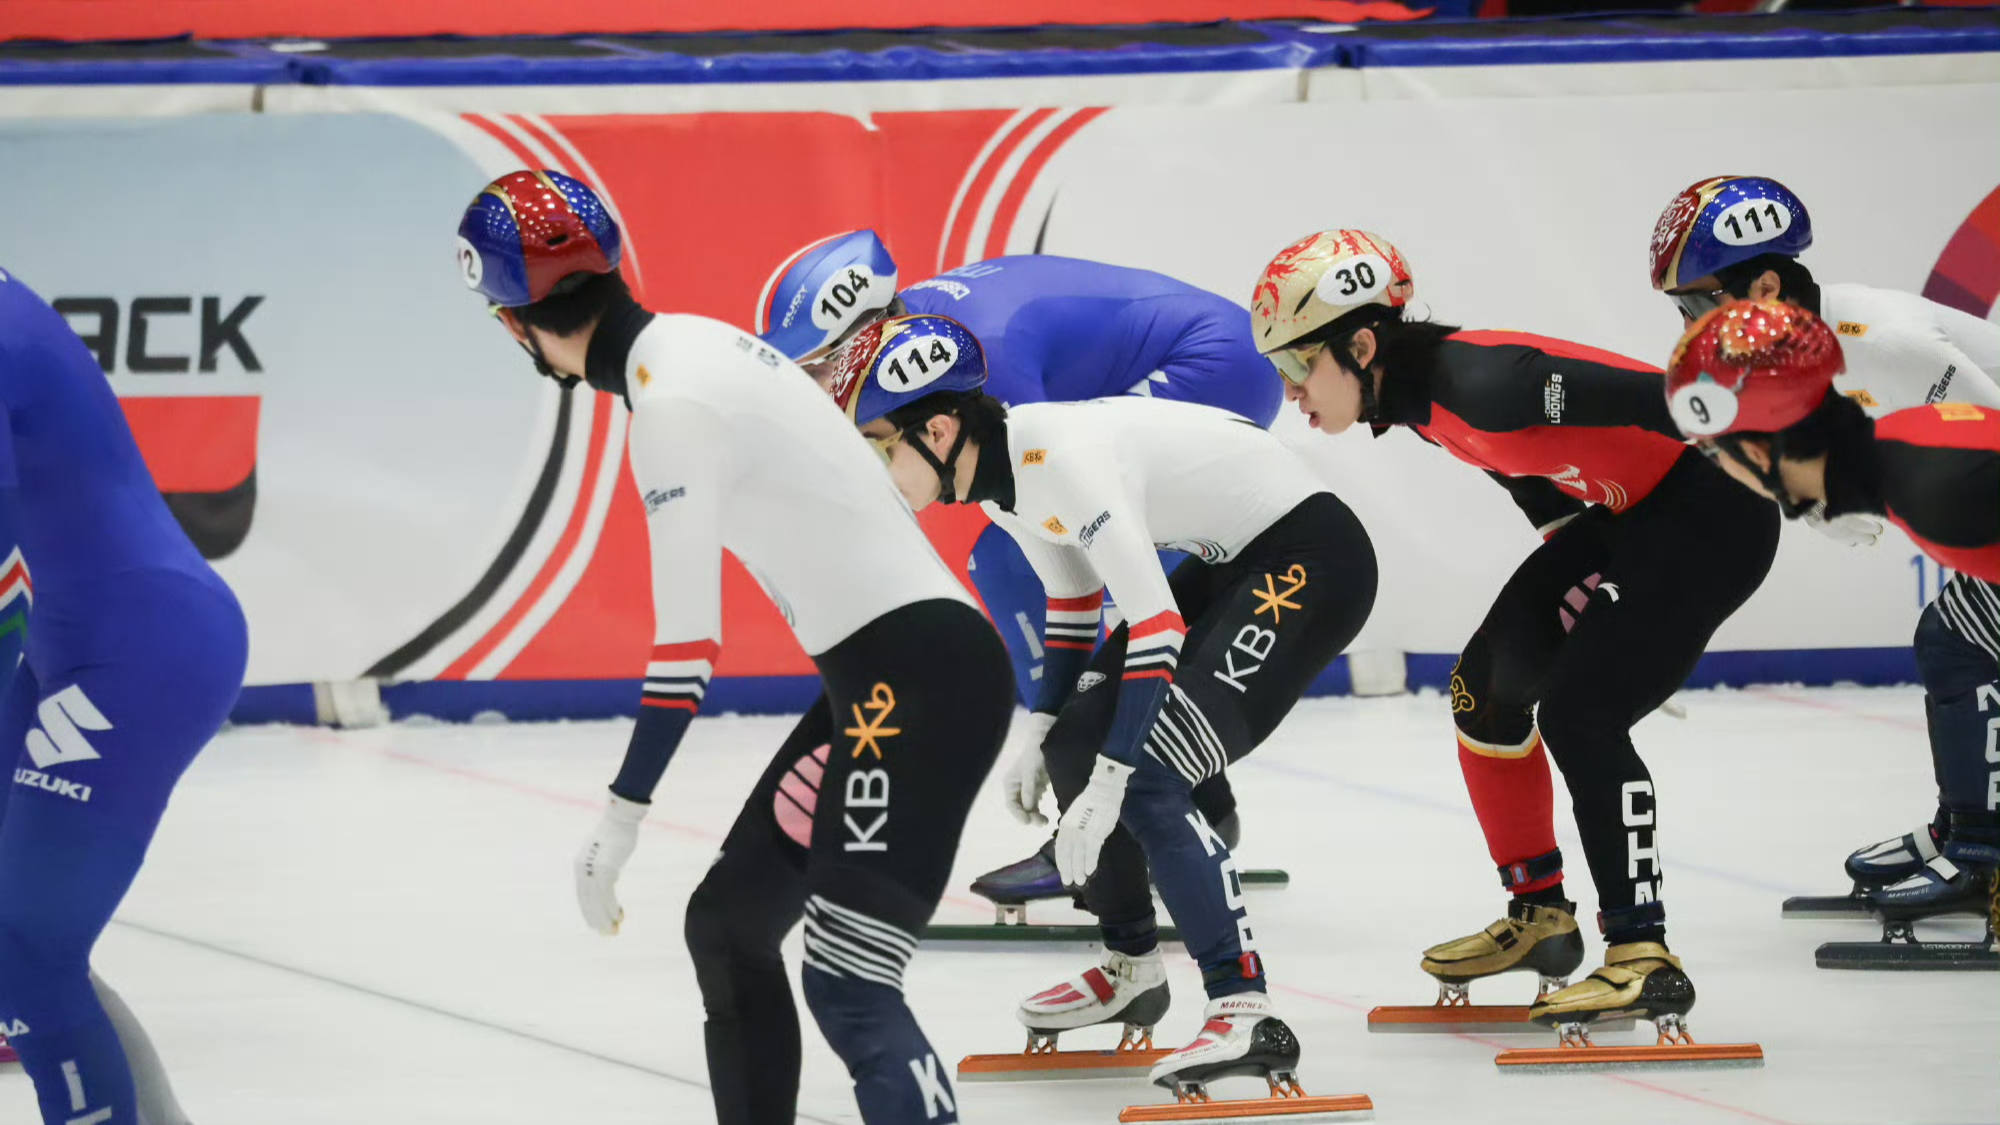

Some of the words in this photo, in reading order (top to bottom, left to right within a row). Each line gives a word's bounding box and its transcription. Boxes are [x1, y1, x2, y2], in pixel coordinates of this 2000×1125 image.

[1724, 203, 1782, 240] 111
[457, 248, 477, 280] 2
[1335, 261, 1376, 296] 30
[782, 284, 808, 329] RUDY
[821, 269, 870, 321] 104
[888, 338, 952, 386] 114
[1934, 364, 1957, 400] TIGERS
[1550, 373, 1563, 425] LOONGS
[1689, 395, 1711, 425] 9
[1082, 510, 1112, 543] TIGERS
[1213, 624, 1276, 693] KB
[844, 768, 889, 852] KB
